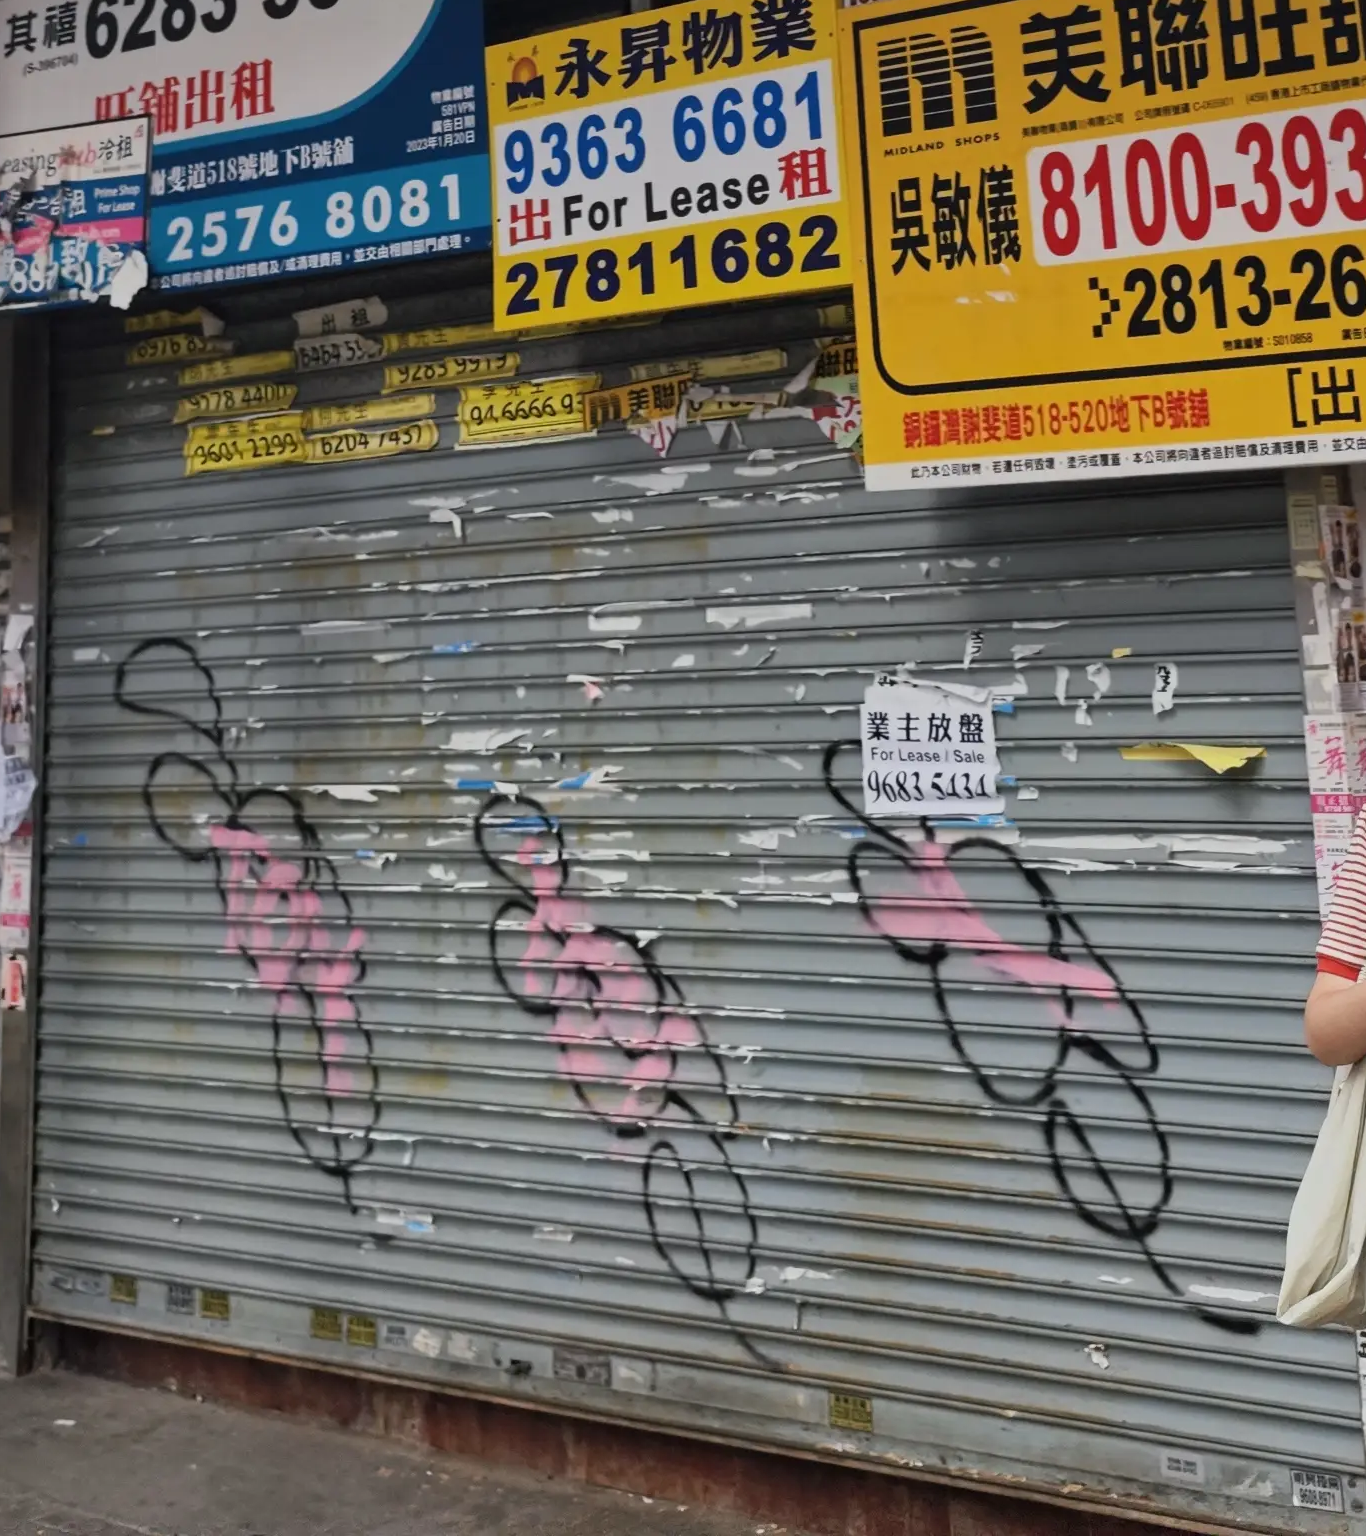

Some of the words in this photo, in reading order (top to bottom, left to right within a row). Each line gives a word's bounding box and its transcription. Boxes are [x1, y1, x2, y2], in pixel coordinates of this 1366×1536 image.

[94, 57, 276, 137] 旺舖出租
[503, 106, 647, 195] 9363
[671, 69, 823, 164] 6681
[883, 140, 945, 157] MIDLAND
[955, 132, 1001, 149] SHOPS
[165, 199, 300, 264] 2576
[324, 172, 462, 240] 8081
[508, 198, 552, 247] 出
[562, 193, 629, 237] For
[644, 173, 771, 223] Lease
[778, 146, 833, 202] 租
[889, 163, 1023, 278] 吳敏儀
[505, 213, 842, 317] 27811682
[866, 711, 985, 744] 業主放盤
[871, 747, 895, 762] For
[899, 748, 941, 764] Lease
[954, 750, 985, 764] Sale
[866, 770, 924, 803] 9683
